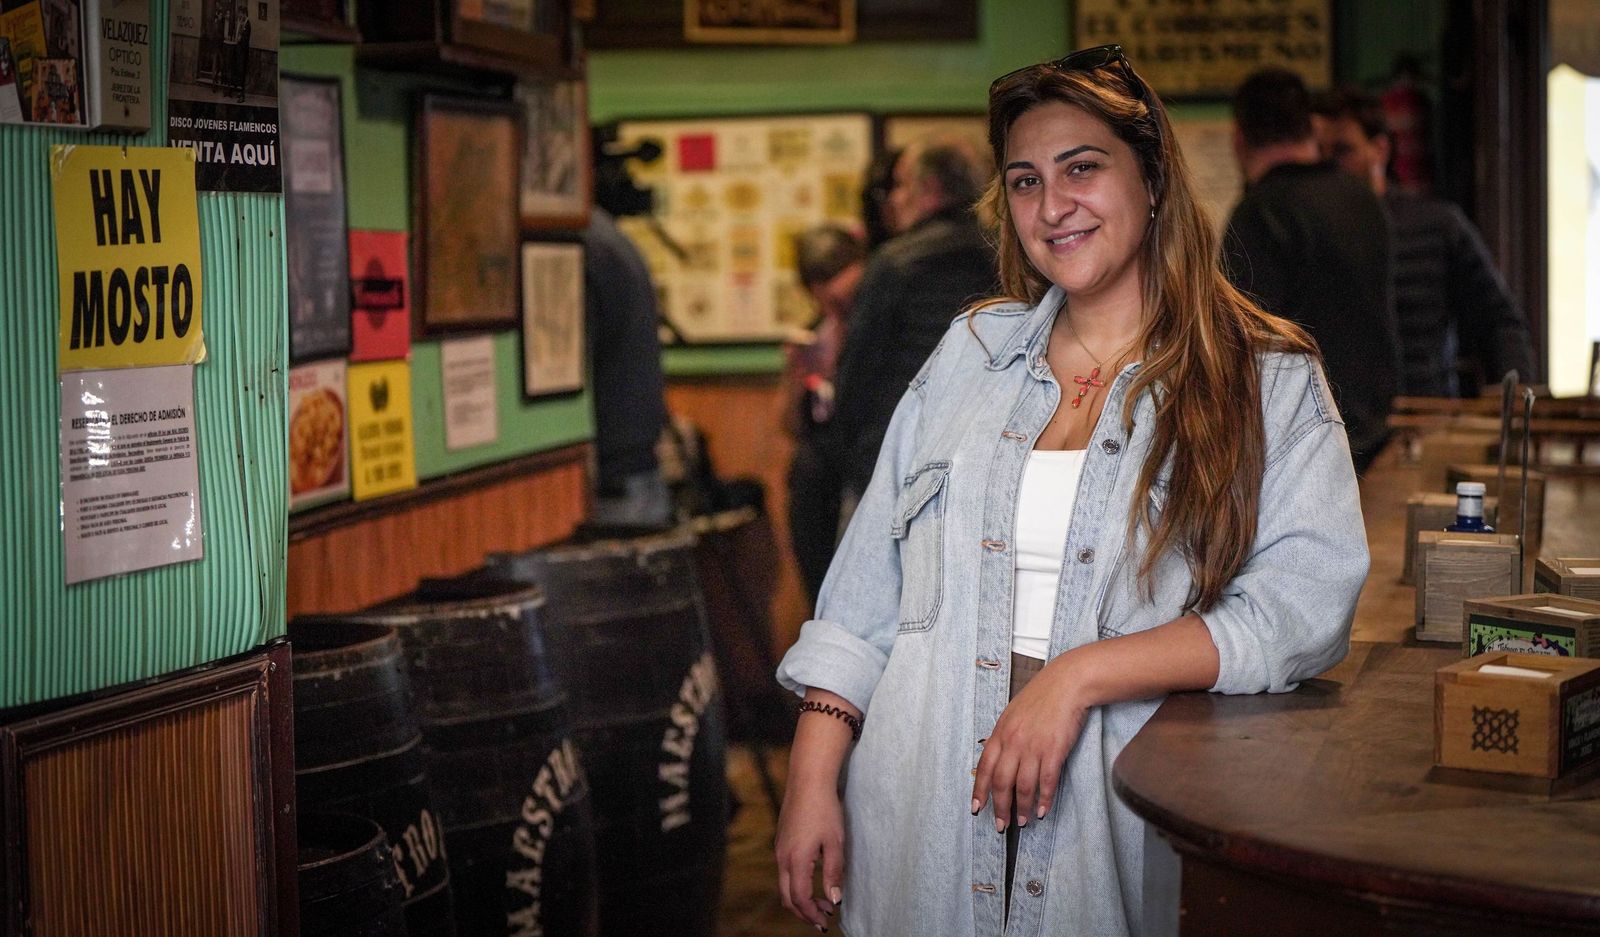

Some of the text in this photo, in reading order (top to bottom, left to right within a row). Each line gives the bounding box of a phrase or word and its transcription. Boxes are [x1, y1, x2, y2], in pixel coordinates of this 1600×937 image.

[101, 19, 148, 46] VELAZQUEZ
[109, 47, 141, 66] OPTICO
[112, 92, 140, 104] FRONTERA
[170, 117, 277, 133] DISCO JOVENES FLAMENCOS
[231, 140, 276, 166] AQUÍ
[89, 169, 161, 246] HAY
[70, 263, 193, 350] MOSTO
[111, 412, 119, 426] EL
[119, 410, 150, 425] DERECHO
[150, 409, 158, 422] DE
[158, 405, 186, 420] ADMISIÓN
